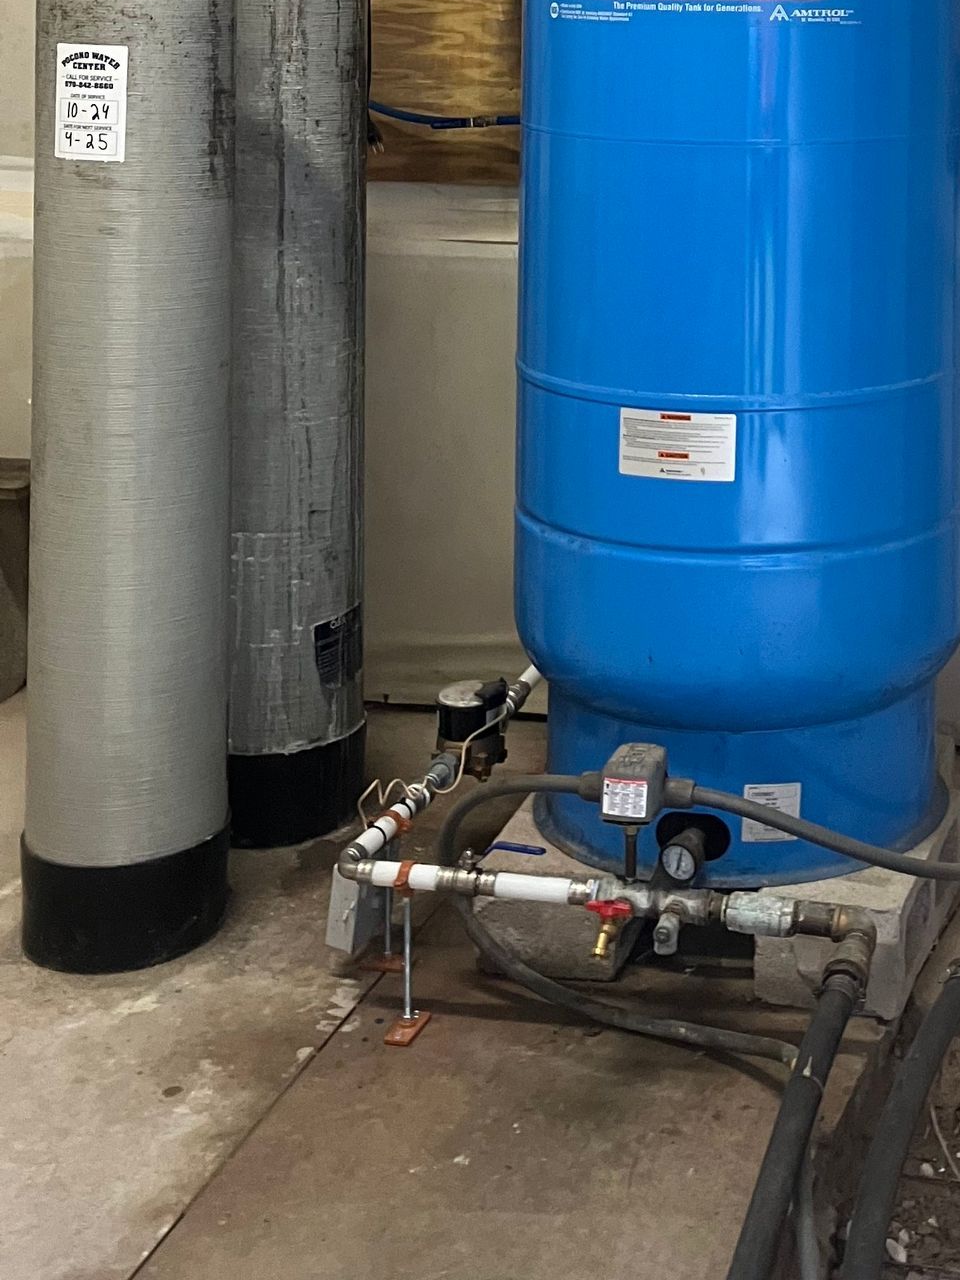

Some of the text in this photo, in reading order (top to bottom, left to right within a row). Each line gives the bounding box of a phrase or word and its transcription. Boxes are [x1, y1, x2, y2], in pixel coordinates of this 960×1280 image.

[613, 1, 625, 10] The
[626, 2, 656, 11] Premium
[658, 2, 683, 12] Quality
[685, 3, 702, 12] Tank
[703, 3, 714, 12] for
[790, 9, 849, 17] AMTROL
[61, 51, 121, 70] POCONO WATER
[72, 62, 106, 71] CENTER
